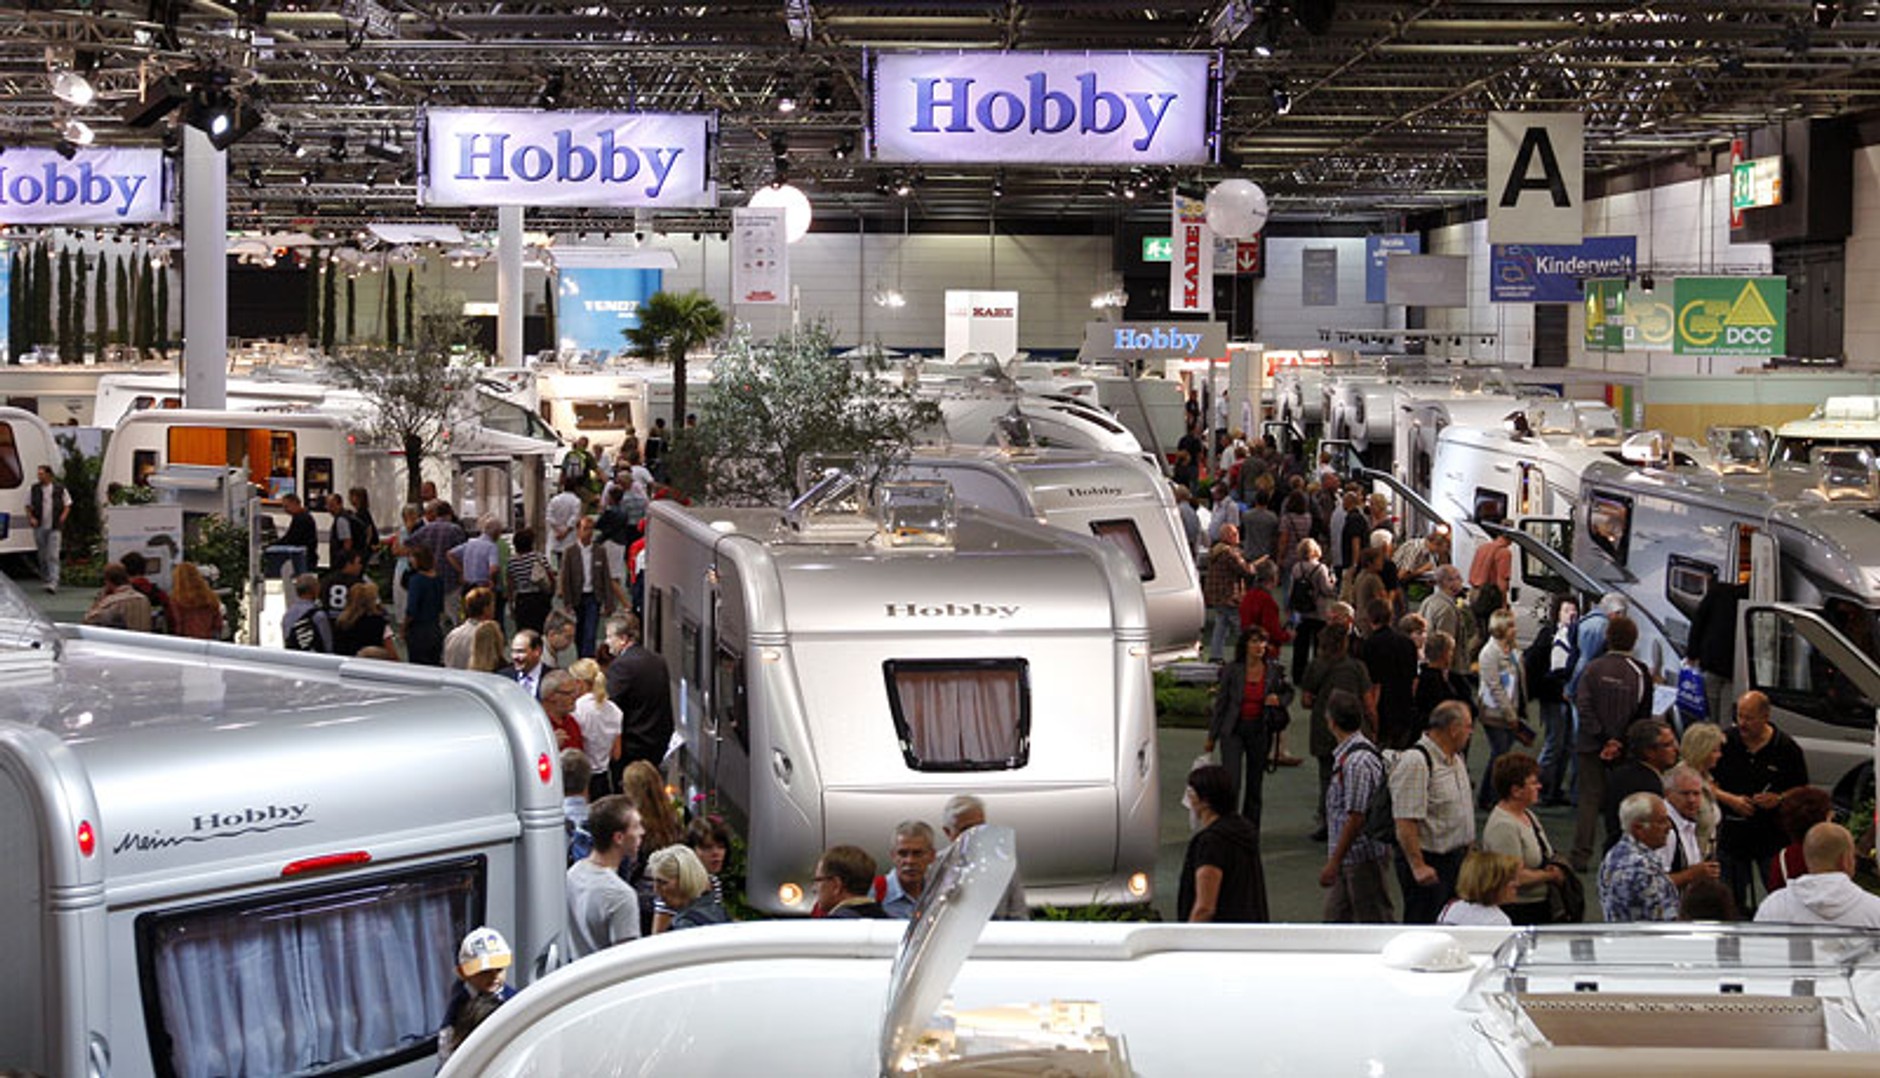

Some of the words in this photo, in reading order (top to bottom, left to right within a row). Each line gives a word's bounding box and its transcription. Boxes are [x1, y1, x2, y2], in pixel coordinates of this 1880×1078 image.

[910, 71, 1178, 151] Hobby
[454, 129, 685, 198] Hobby
[1499, 126, 1571, 208] A
[1536, 255, 1632, 274] Kinderwelt
[1114, 326, 1203, 354] Hobby
[1726, 327, 1772, 344] DCC
[1067, 486, 1122, 497] Hobby
[884, 602, 1021, 619] Hobby
[113, 829, 186, 854] Mein
[192, 804, 310, 832] Hobby
